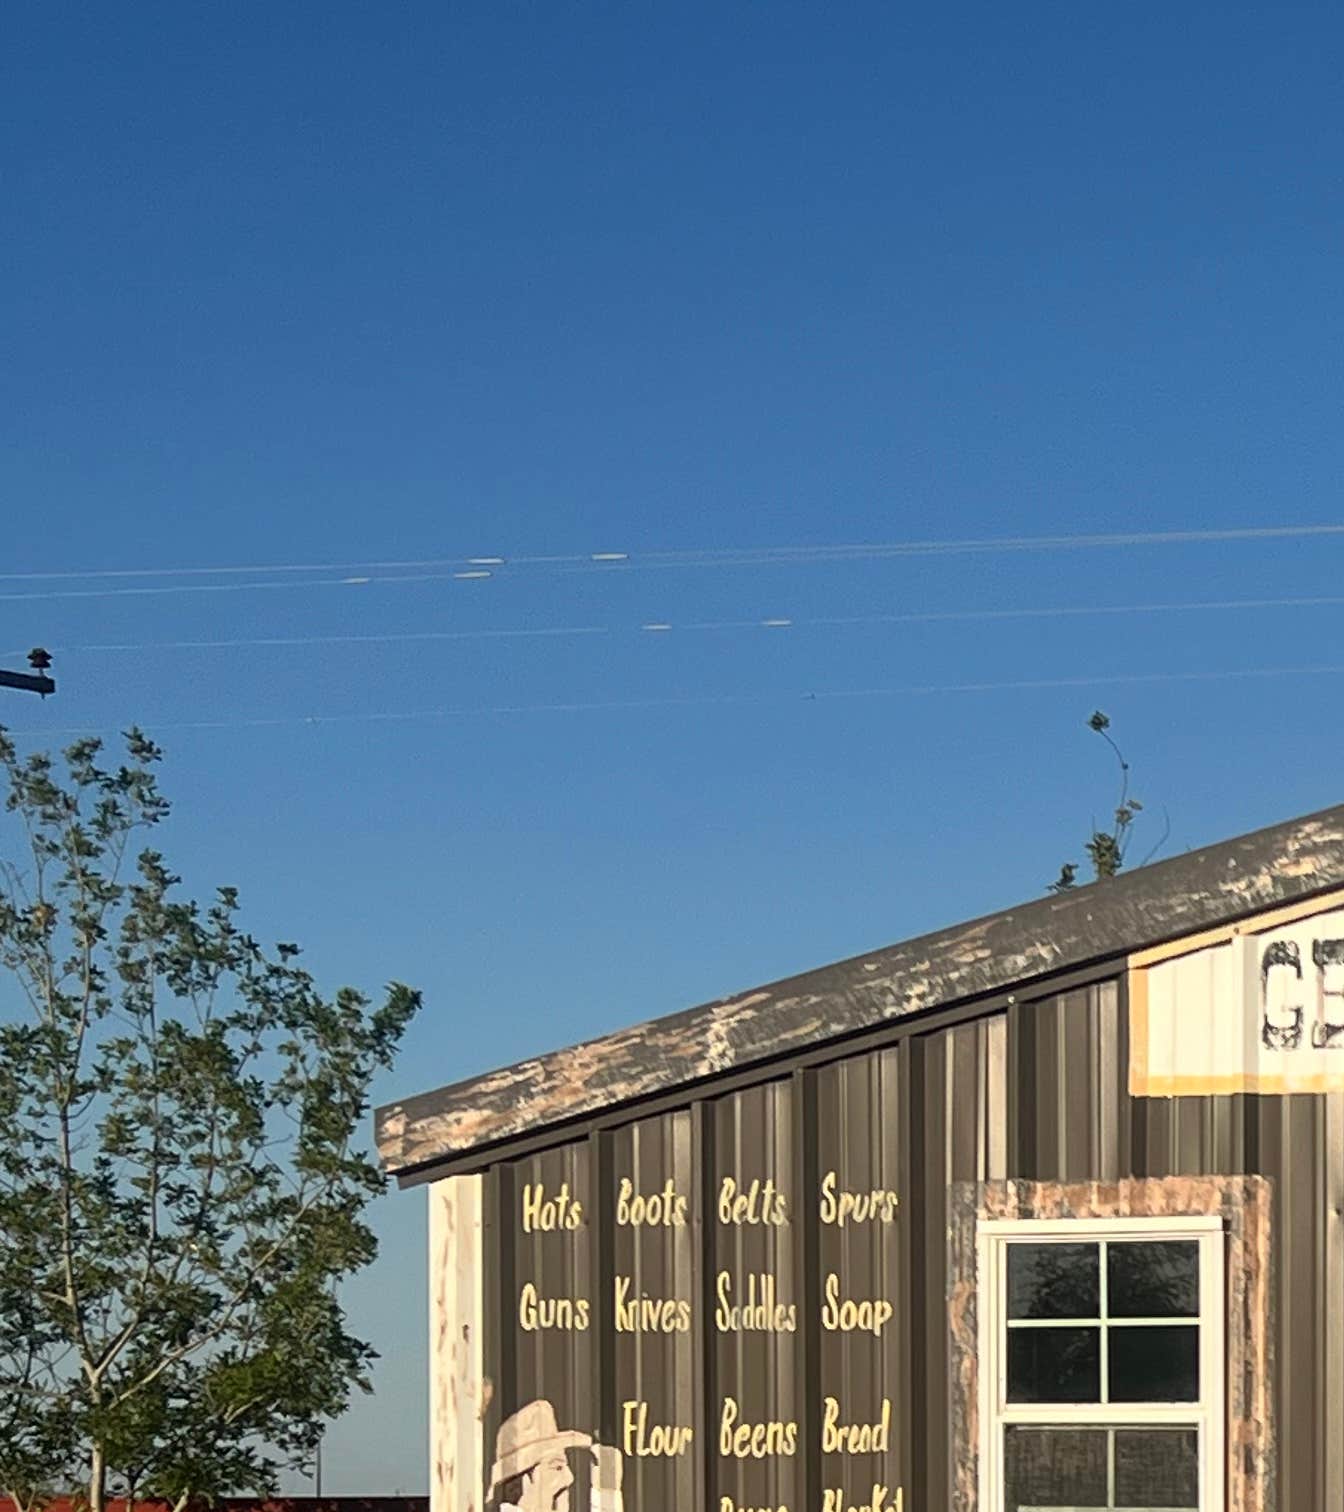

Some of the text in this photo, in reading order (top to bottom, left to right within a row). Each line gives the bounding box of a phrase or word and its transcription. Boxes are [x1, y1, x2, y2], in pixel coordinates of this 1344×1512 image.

[522, 1171, 898, 1232] Hats Boots Belts Spurs
[519, 1283, 590, 1331] Guns
[822, 1274, 893, 1336] Soap
[719, 1397, 797, 1458] Beens
[822, 1397, 891, 1453] Bread
